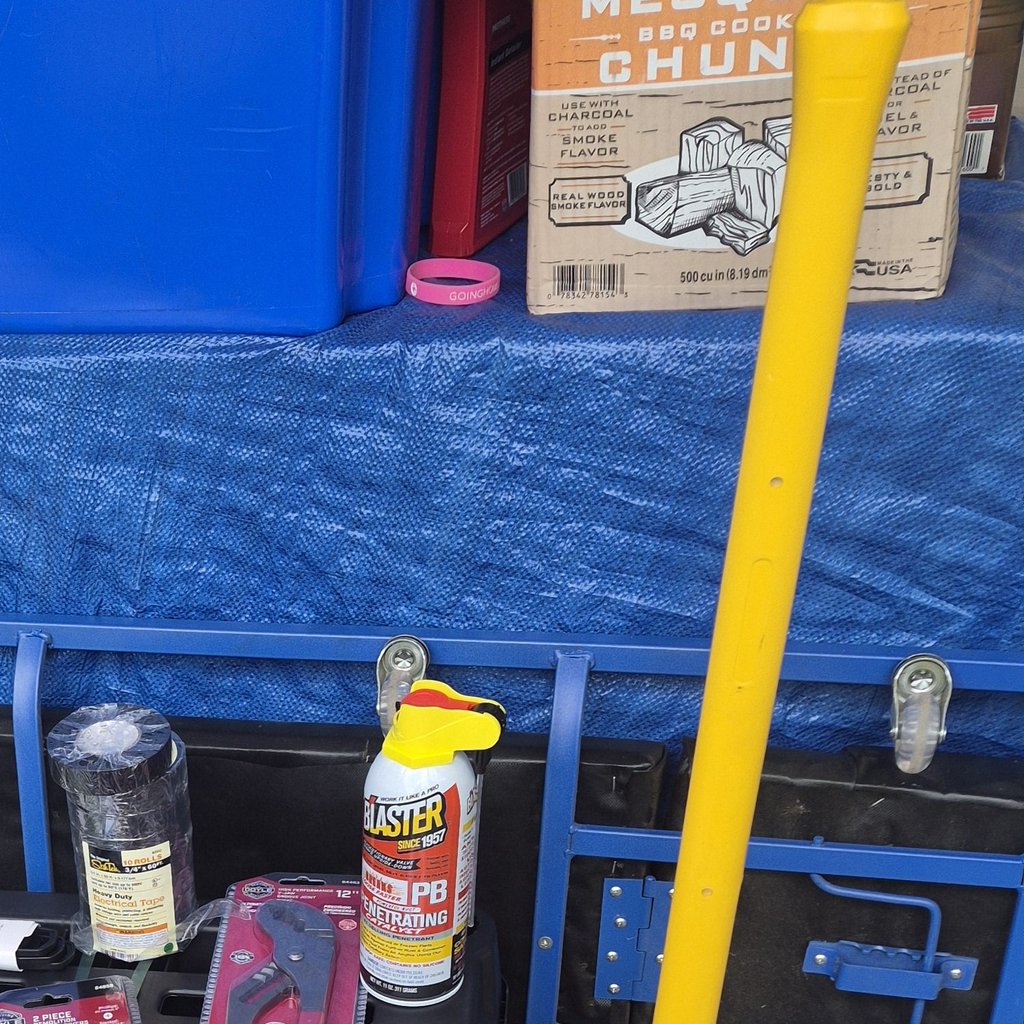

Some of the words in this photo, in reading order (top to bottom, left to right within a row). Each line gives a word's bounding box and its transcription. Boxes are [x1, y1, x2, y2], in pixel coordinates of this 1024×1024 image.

[639, 23, 696, 42] BBQ
[711, 13, 793, 36] COOK
[599, 36, 788, 84] CHUN
[895, 73, 929, 83] TEAD
[933, 69, 952, 78] OF
[561, 101, 587, 110] USE
[590, 100, 619, 108] WITH
[548, 109, 633, 122] CHARCOAL
[562, 134, 617, 144] SMOKE
[560, 147, 618, 158] FLAVOR
[552, 192, 584, 200] REAL
[587, 191, 624, 199] WOOD
[551, 202, 586, 210] SMOKE
[588, 200, 626, 209] FLAVOR
[680, 270, 699, 283] 500
[701, 272, 713, 281] cu
[714, 270, 724, 281] in
[727, 268, 750, 281] (8.19
[877, 264, 912, 275] USA
[427, 784, 439, 793] PRO
[364, 793, 443, 837] BLASTER
[397, 838, 421, 850] SINCE
[421, 828, 446, 848] 1957
[134, 854, 162, 864] ROLLS
[92, 888, 112, 898] Heavy
[336, 890, 360, 898] 12"
[411, 879, 448, 905] PB
[93, 894, 136, 908] Electrical
[140, 896, 165, 907] Tape
[364, 898, 448, 928] ENETRATING
[365, 913, 426, 934] CATALYST
[42, 1011, 72, 1020] PIECE
